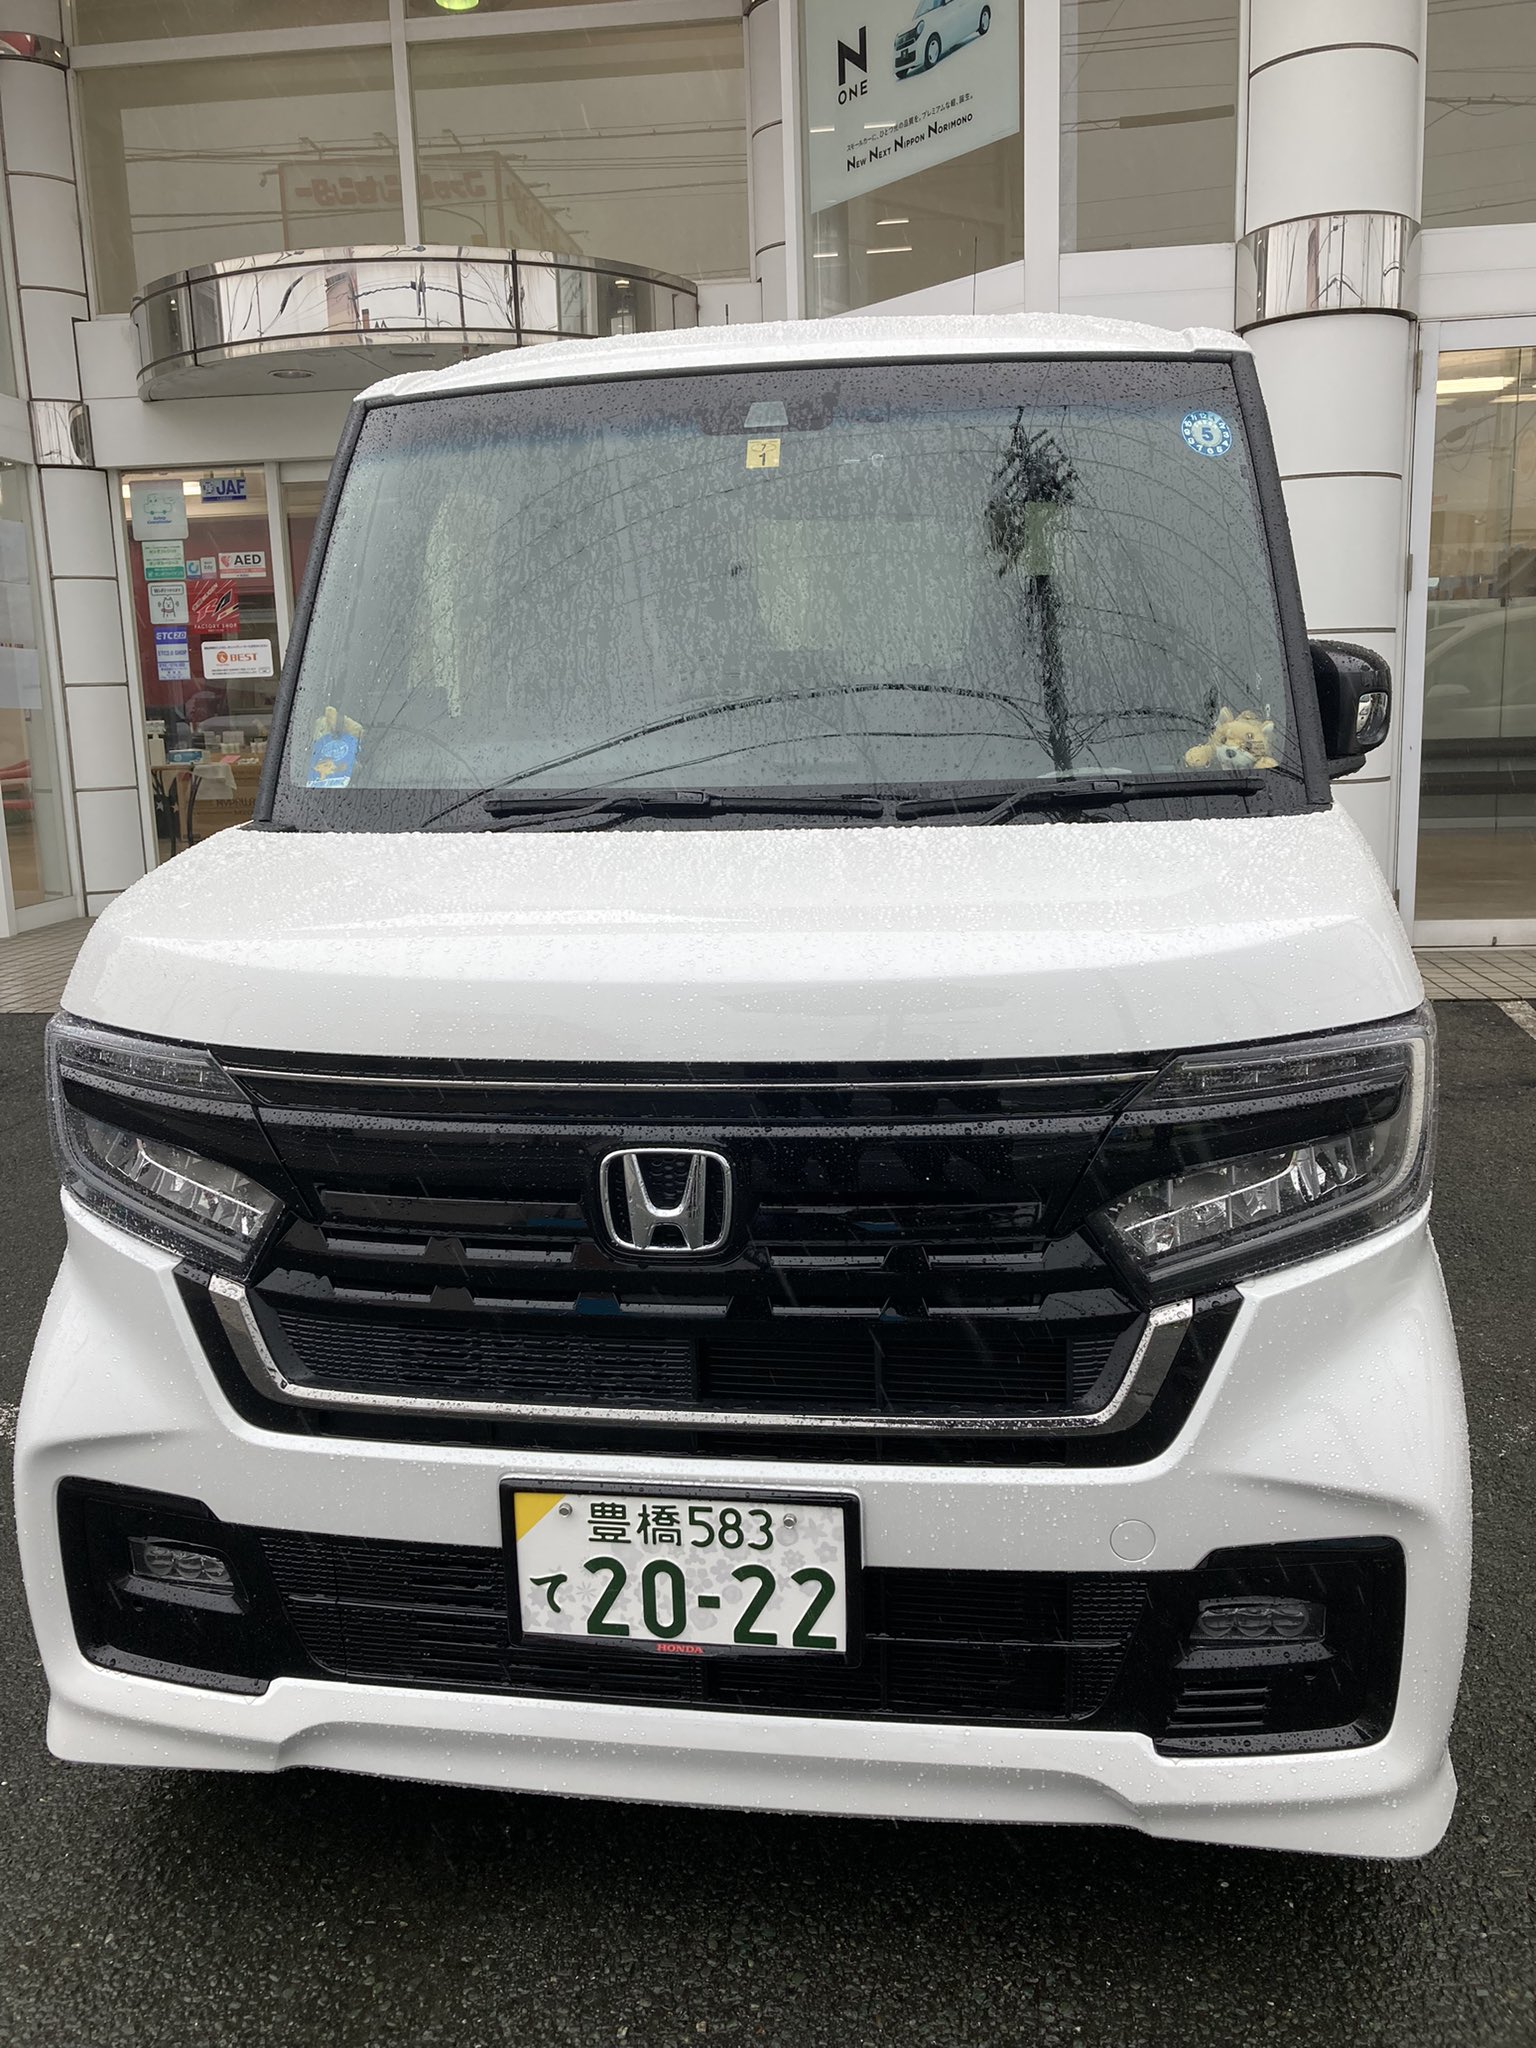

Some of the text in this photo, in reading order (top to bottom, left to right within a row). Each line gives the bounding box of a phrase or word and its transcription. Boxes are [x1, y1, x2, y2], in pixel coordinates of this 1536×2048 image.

[837, 25, 867, 86] N
[838, 79, 868, 105] ONE
[1201, 427, 1214, 442] 5
[758, 453, 766, 466] 1
[216, 479, 246, 495] JAF
[234, 554, 262, 566] AED
[230, 652, 258, 662] BEST
[587, 1501, 774, 1551] 豊橋 583
[529, 1556, 838, 1650] て 20-22
[655, 1643, 704, 1654] HONDA
